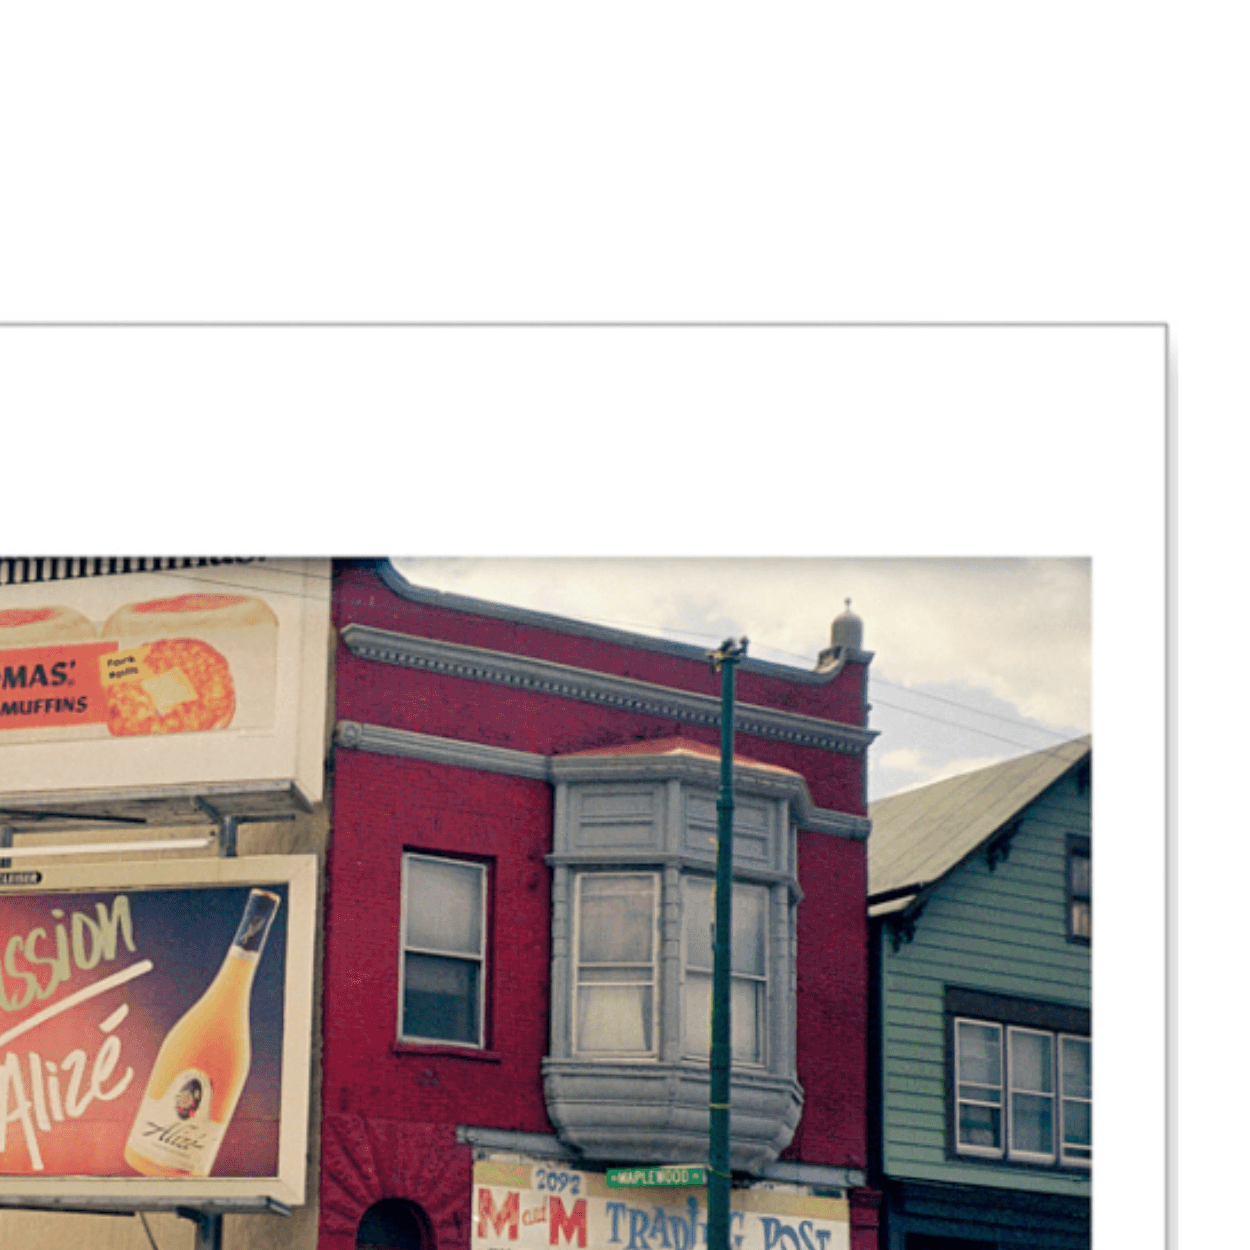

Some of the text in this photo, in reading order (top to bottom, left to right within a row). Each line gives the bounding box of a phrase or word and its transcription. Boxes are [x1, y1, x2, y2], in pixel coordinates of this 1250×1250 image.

[0, 695, 89, 717] MUFFINS
[535, 1167, 581, 1196] 2092
[477, 1187, 520, 1242] M
[549, 1195, 588, 1249] M
